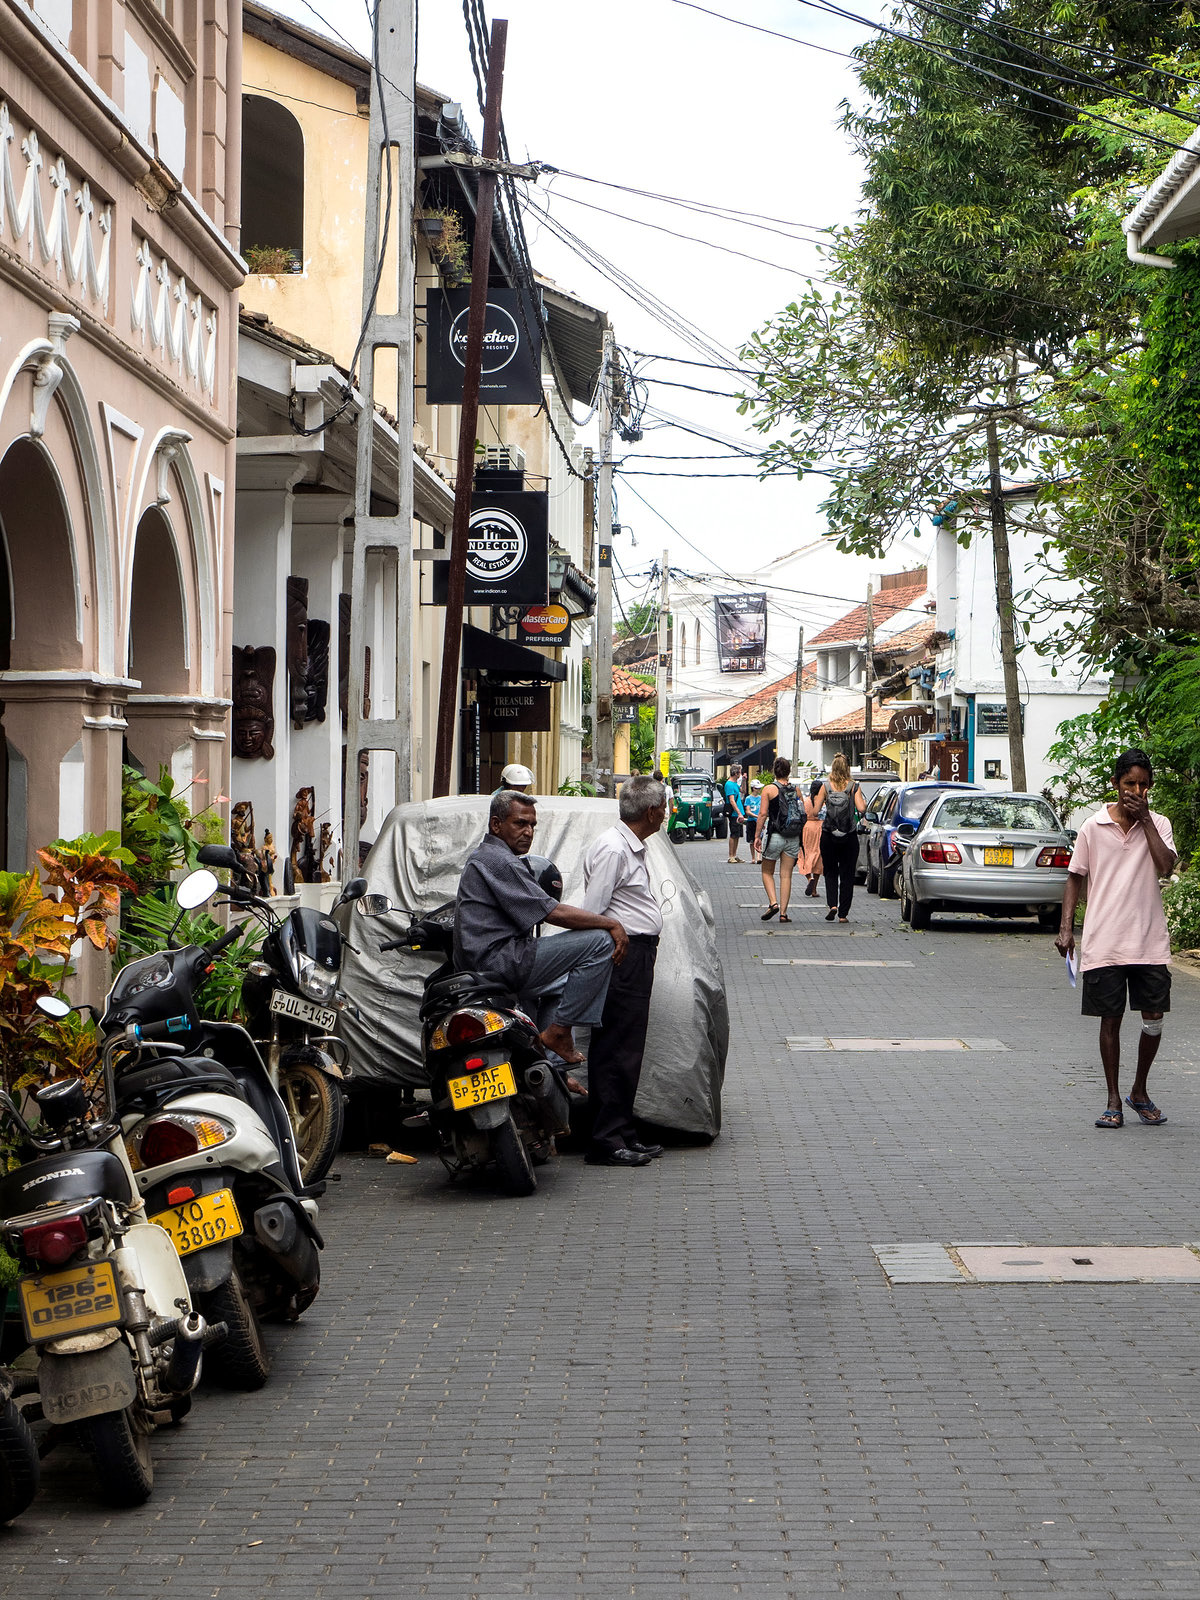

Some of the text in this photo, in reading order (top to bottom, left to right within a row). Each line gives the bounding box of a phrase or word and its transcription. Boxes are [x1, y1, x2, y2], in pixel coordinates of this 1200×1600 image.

[468, 541, 518, 550] NDECON
[472, 556, 510, 570] REAL ESTATE
[521, 614, 568, 625] MasterCard
[494, 696, 535, 706] TREASURE
[493, 707, 519, 717] CHEST
[470, 1067, 500, 1089] BAF
[454, 1082, 507, 1103] SP 3720
[22, 1167, 86, 1192] HONDA
[177, 1217, 228, 1251] 3809
[32, 1293, 114, 1325] 0922
[48, 1380, 129, 1413] HONDA
